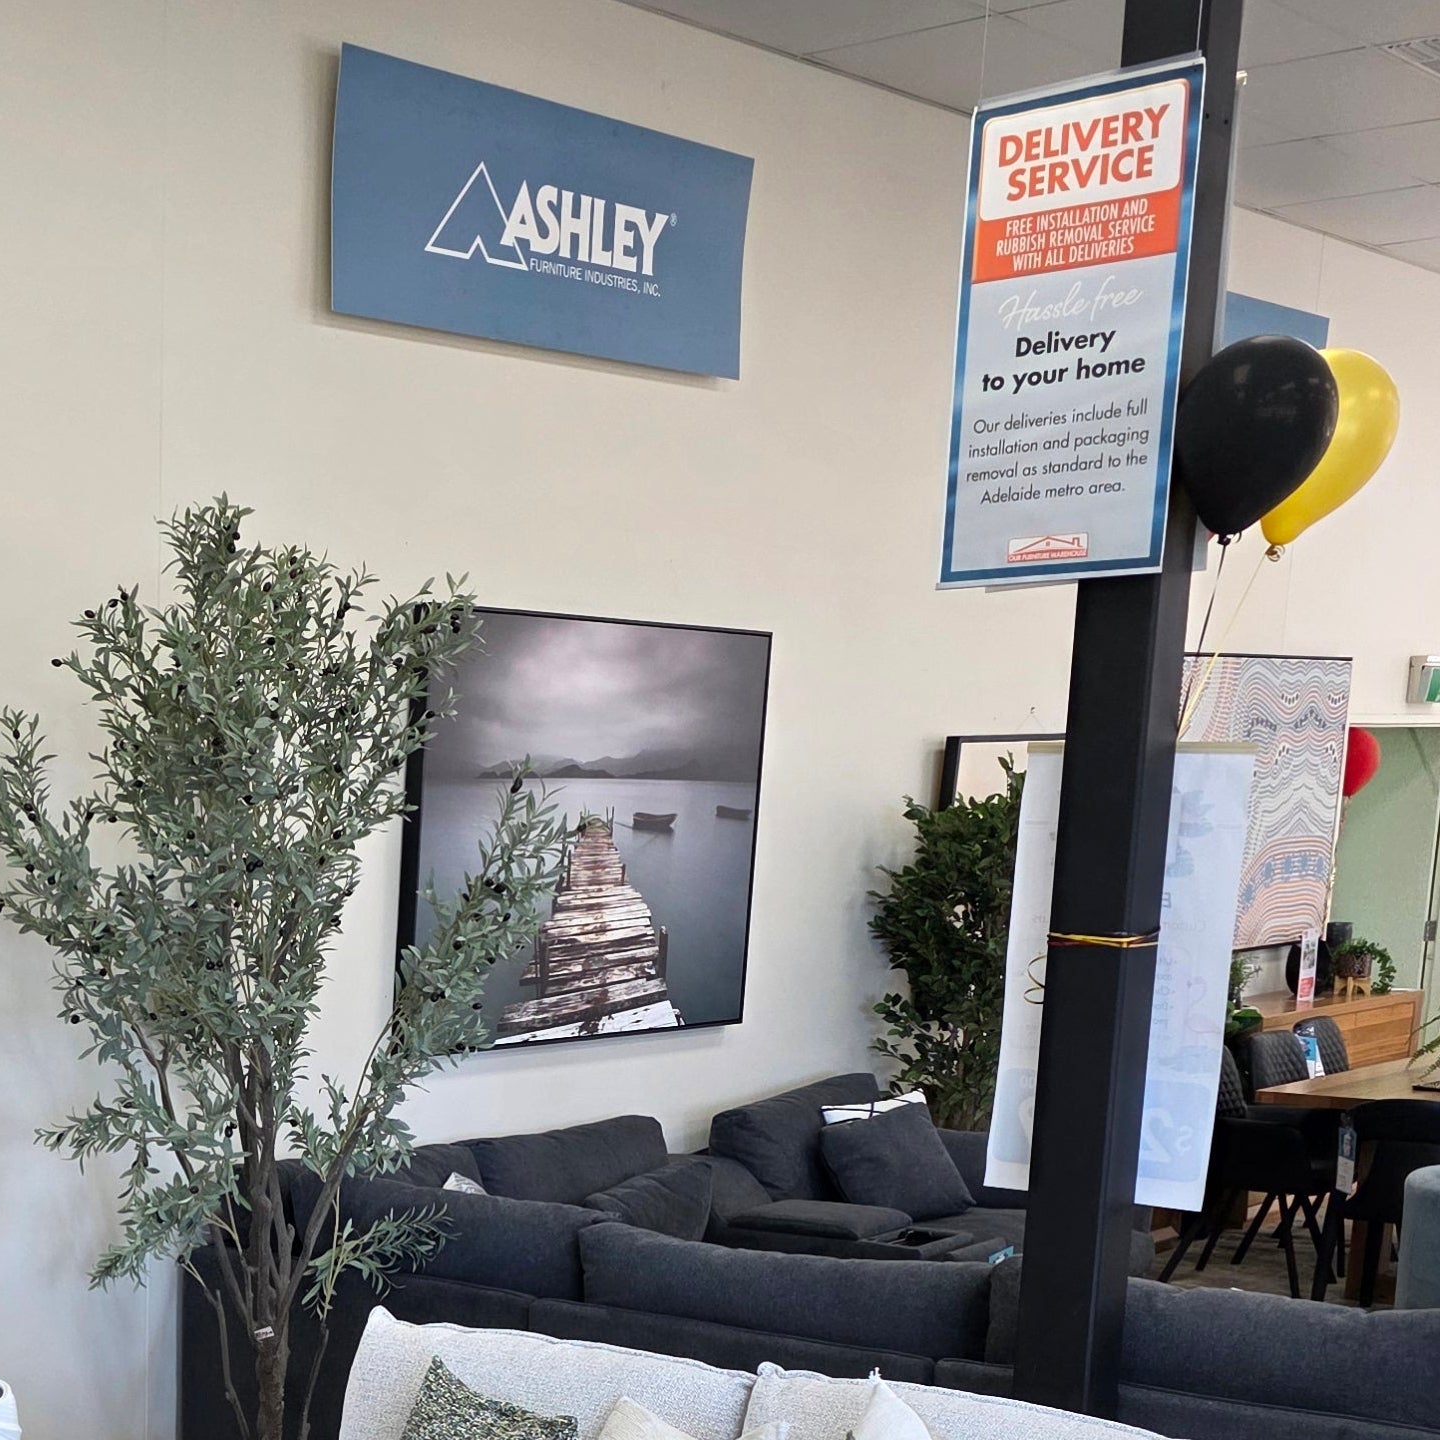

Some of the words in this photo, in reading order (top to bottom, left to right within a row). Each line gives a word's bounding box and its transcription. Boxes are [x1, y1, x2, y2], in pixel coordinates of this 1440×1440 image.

[998, 104, 1170, 167] DELIVERY
[1006, 145, 1154, 201] SERVICE
[500, 180, 669, 276] ASHLEY
[996, 231, 1045, 257] RUBBISH
[1049, 224, 1104, 247] REMOVAL
[1108, 214, 1156, 238] SERVICE
[1005, 217, 1033, 237] FREE
[1036, 203, 1118, 232] INSTALLATION
[1122, 199, 1148, 216] AND
[1013, 252, 1042, 272] WITH
[1045, 247, 1065, 266] ALL
[1069, 237, 1135, 262] DELIVERIES
[530, 258, 582, 280] FURNITURE
[585, 269, 641, 294] INDUSTRIES,
[643, 281, 661, 297] INC.
[998, 281, 1090, 330] Hassle
[1090, 275, 1143, 322] free
[1015, 330, 1116, 357] Delivery
[982, 373, 1004, 392] to
[1012, 365, 1068, 394] your
[1076, 357, 1146, 380] home
[973, 419, 1000, 434] Our
[1004, 411, 1067, 432] deliveries
[1072, 402, 1122, 423] include
[1126, 398, 1148, 416] full
[968, 440, 1038, 458] installation
[1042, 432, 1070, 450] and
[1073, 428, 1149, 451] packaging
[966, 464, 1018, 482] removal
[1022, 466, 1037, 477] as
[1042, 452, 1103, 474] standard
[1107, 454, 1121, 468] to
[1126, 450, 1148, 466] the
[980, 484, 1041, 505] Adelaide
[1045, 484, 1084, 499] metro
[1089, 481, 1126, 495] area.
